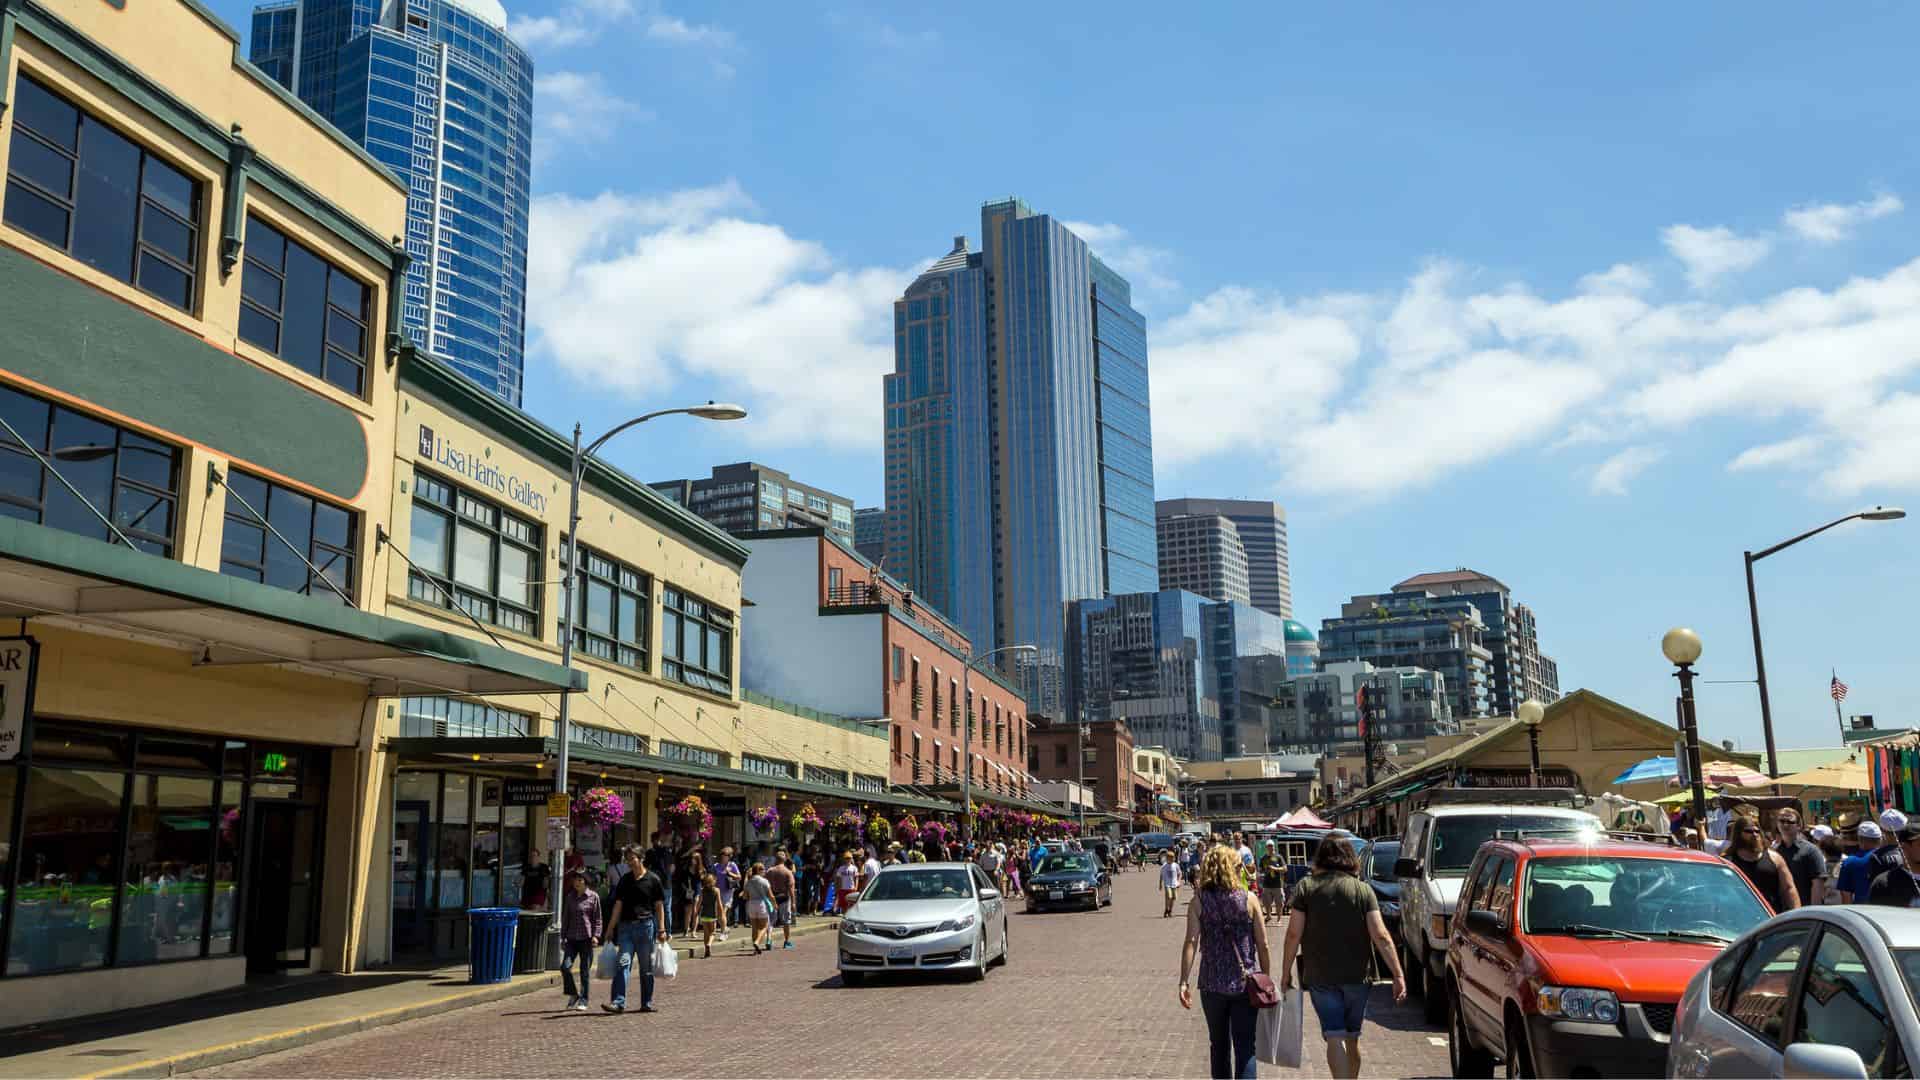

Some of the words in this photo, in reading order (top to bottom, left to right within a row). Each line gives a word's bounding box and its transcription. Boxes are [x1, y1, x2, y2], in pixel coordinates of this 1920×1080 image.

[436, 437, 465, 474] Lisa
[467, 453, 505, 495] Harris
[508, 475, 548, 514] Gallery
